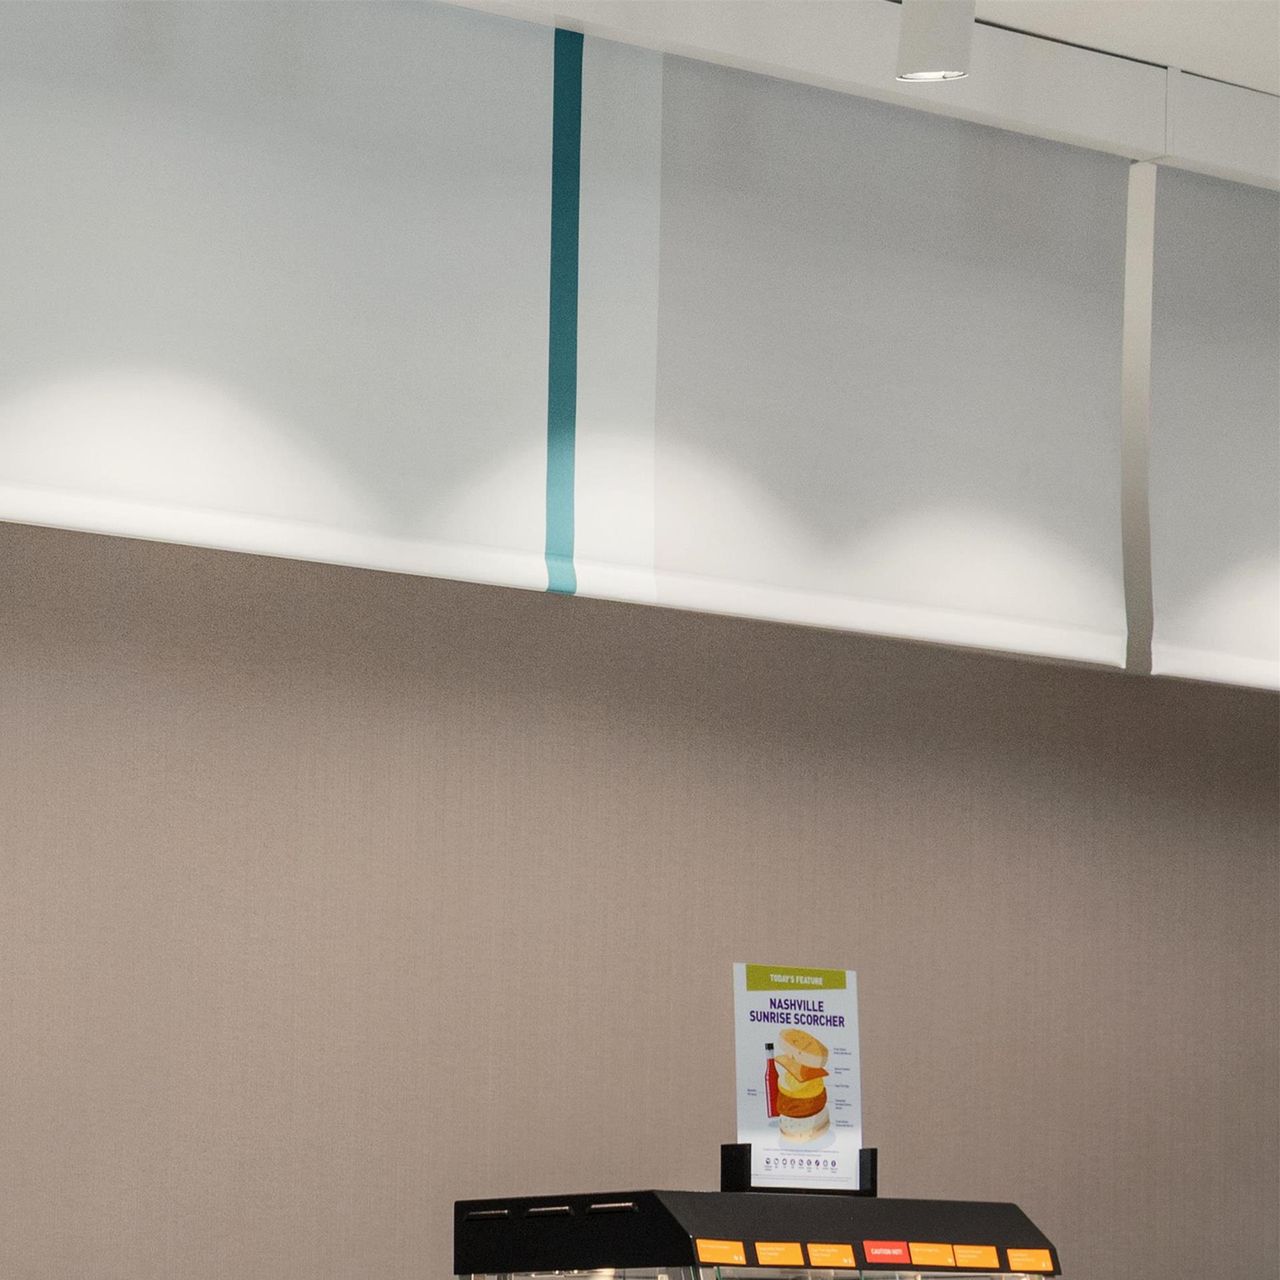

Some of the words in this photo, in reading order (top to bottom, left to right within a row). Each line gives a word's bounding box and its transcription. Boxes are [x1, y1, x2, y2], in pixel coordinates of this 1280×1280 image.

[769, 998, 824, 1012] NASHVILLE
[749, 1010, 791, 1024] SUNRISE
[794, 1013, 845, 1027] SCORCHER
